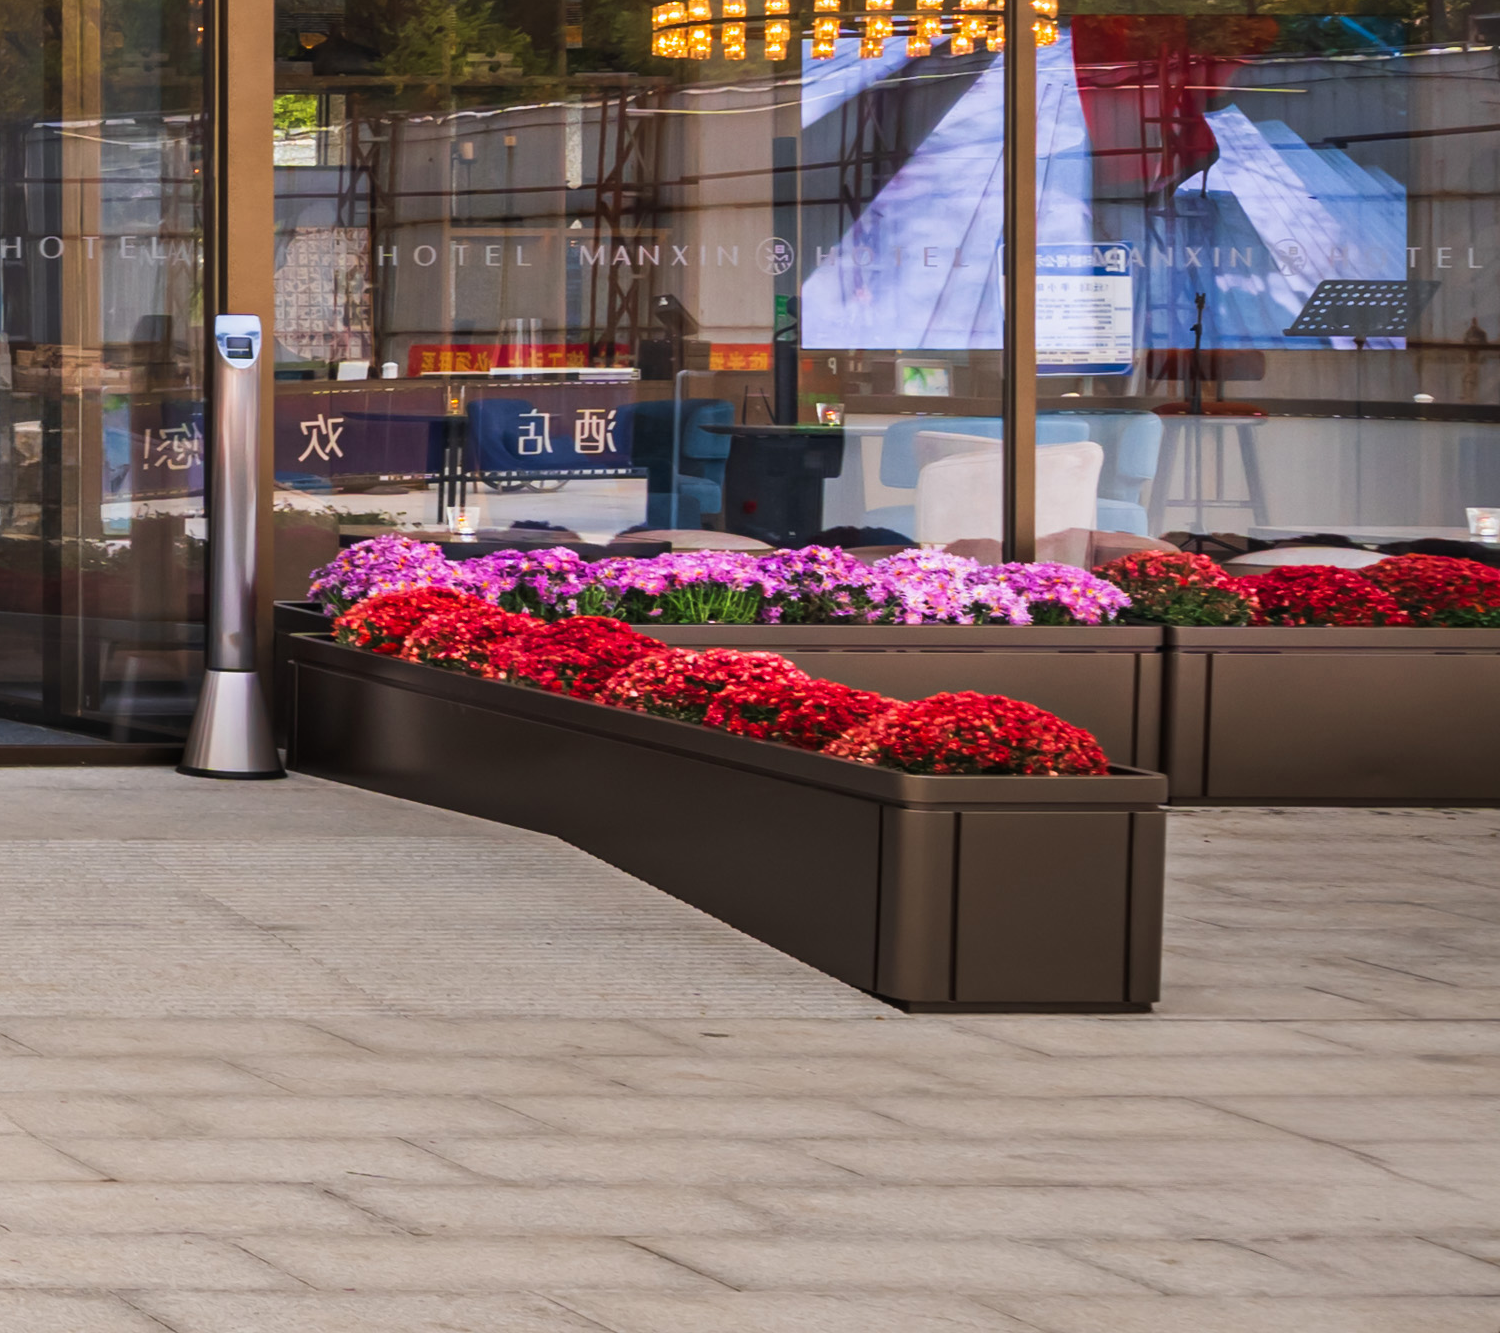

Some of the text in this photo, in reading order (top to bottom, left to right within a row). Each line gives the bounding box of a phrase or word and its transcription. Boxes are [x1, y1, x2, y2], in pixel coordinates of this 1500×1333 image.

[0, 235, 167, 260] HOTEL
[377, 244, 533, 267] HOTEL
[578, 244, 970, 268] MANXIN HOTEL
